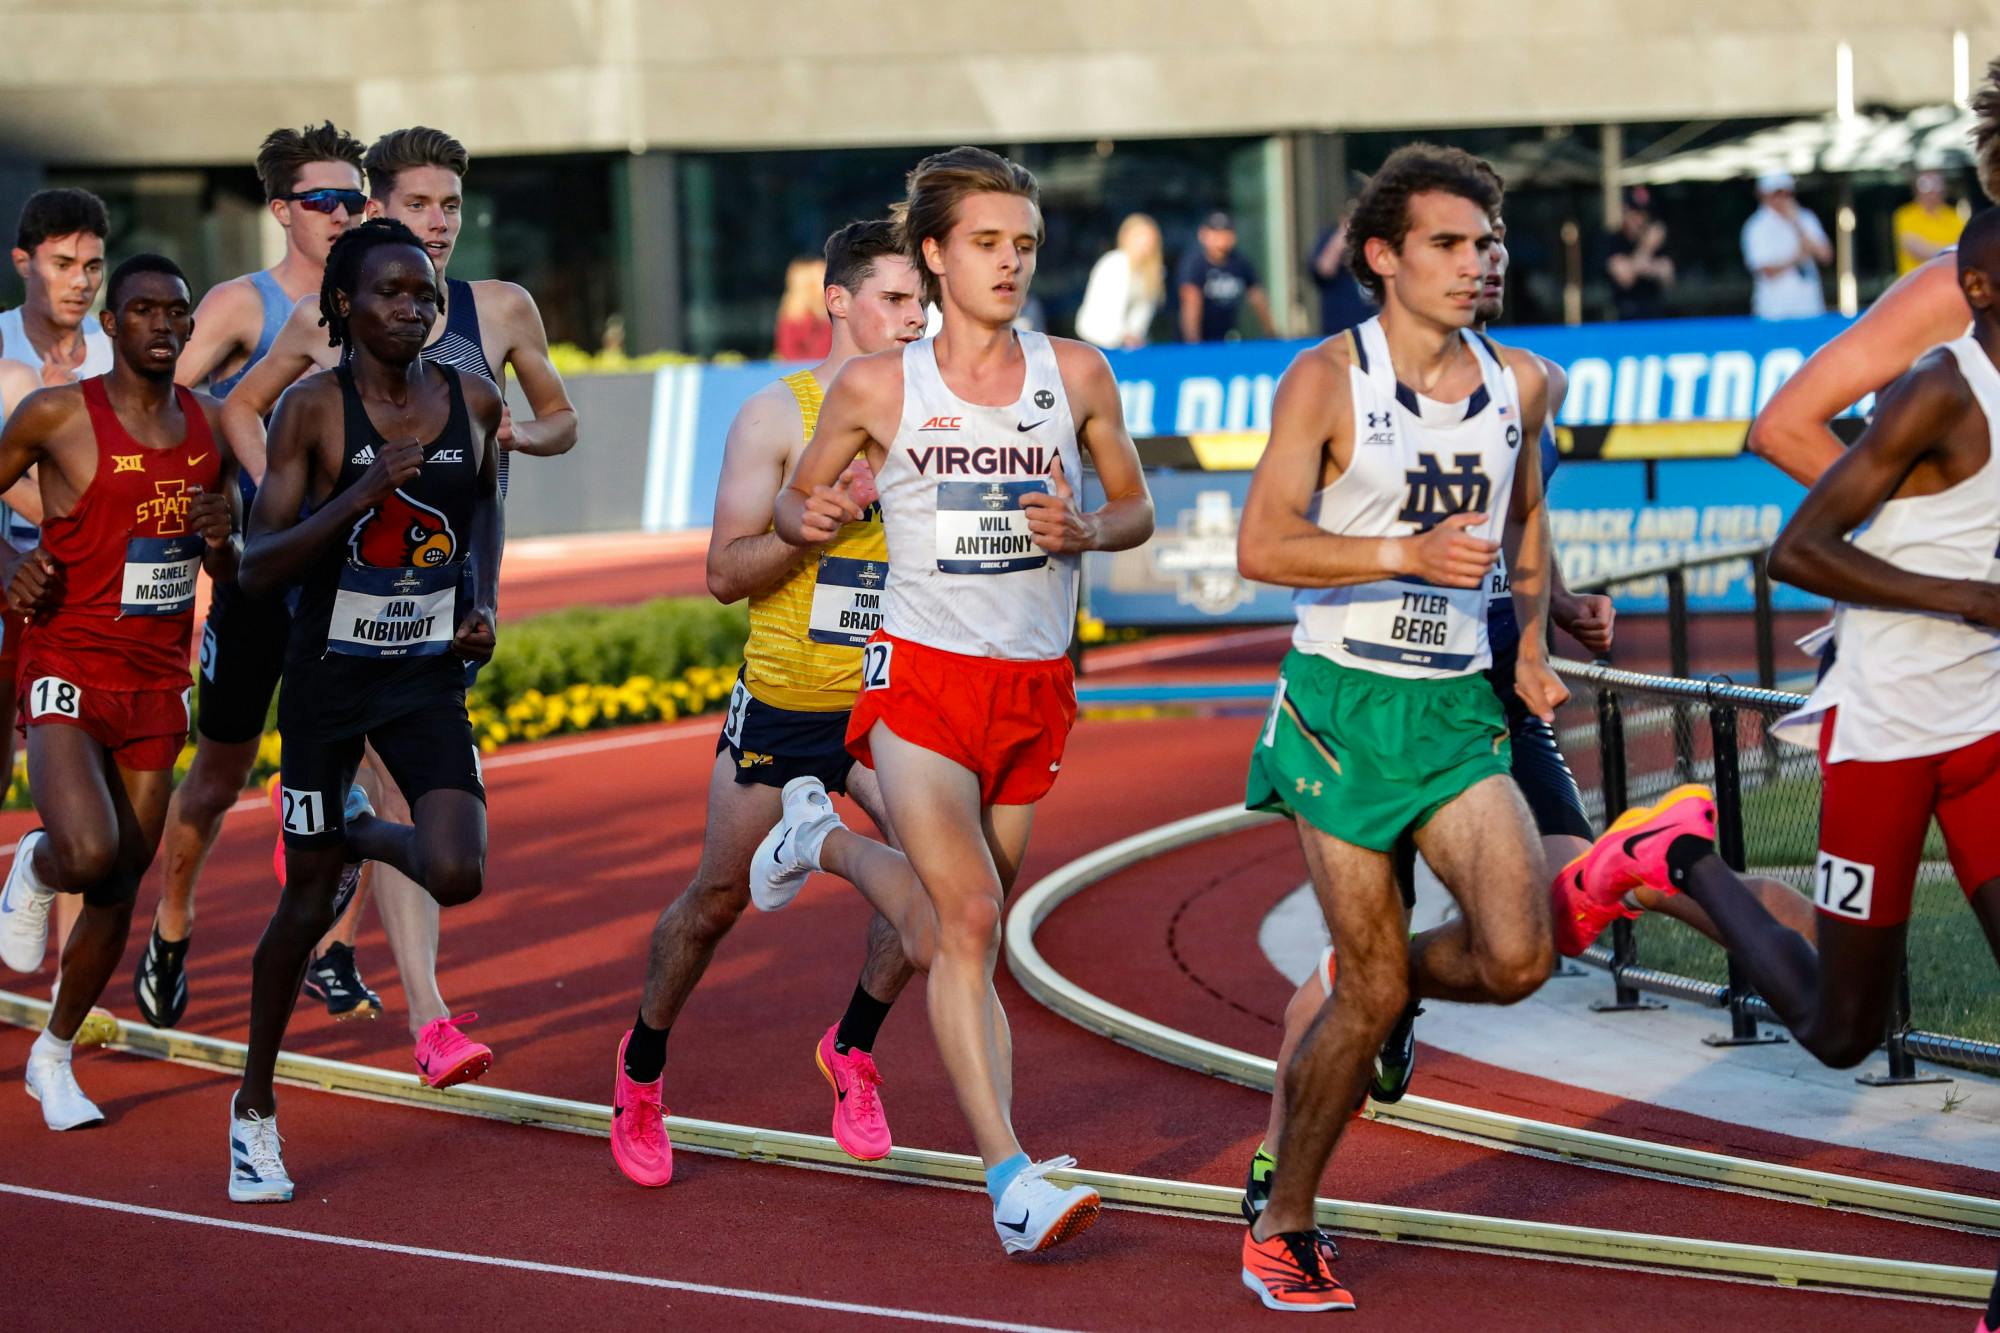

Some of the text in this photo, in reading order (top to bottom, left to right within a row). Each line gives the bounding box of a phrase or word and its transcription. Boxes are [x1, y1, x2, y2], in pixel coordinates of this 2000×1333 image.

[922, 417, 963, 428] ACC
[1368, 432, 1395, 442] ACC
[112, 454, 146, 473] XII
[429, 449, 464, 461] ACC
[979, 516, 1012, 532] WILL
[1636, 505, 1698, 540] AND
[1701, 503, 1783, 542] FIELD
[955, 535, 1032, 555] ANTHONY
[152, 565, 188, 581] SANELE
[135, 579, 193, 600] MASONDO
[386, 602, 415, 617] IAN
[854, 593, 880, 609] TOM
[1402, 592, 1449, 616] TYLER
[353, 615, 435, 641] KIBIWOT
[1391, 616, 1448, 646] BERG
[36, 679, 77, 714] 18
[283, 790, 316, 833] 21
[1821, 859, 1865, 915] 12
